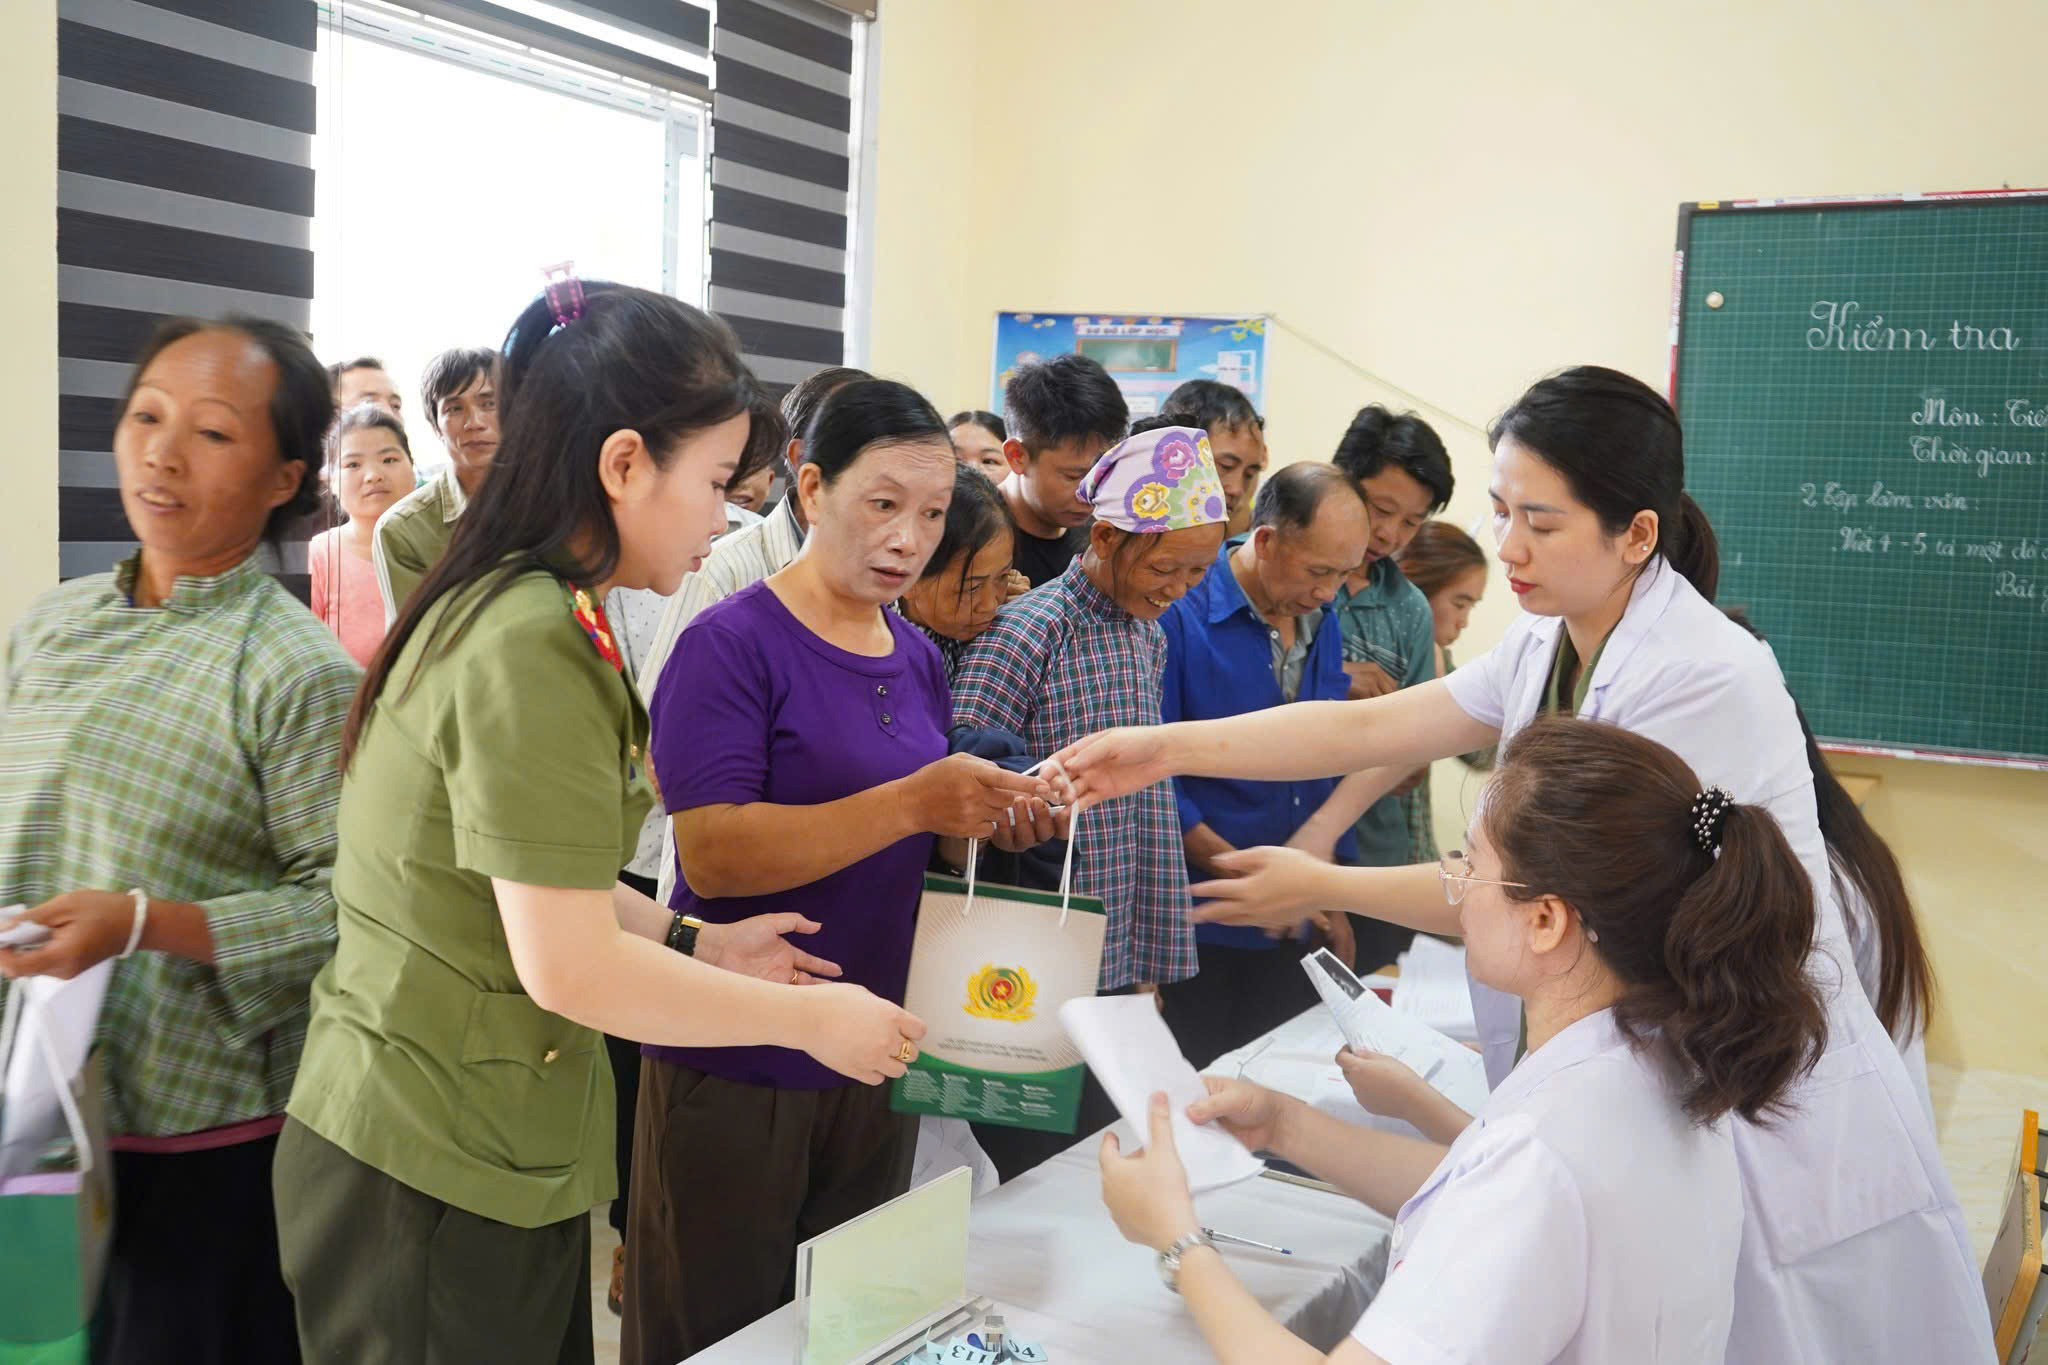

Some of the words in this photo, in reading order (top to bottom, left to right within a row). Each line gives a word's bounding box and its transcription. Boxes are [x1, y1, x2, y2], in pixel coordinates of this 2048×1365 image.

[1806, 301, 1936, 351] Kiểm
[1949, 319, 2020, 351] tra
[1911, 398, 1984, 427] Môn
[1909, 436, 1971, 464] Thời
[1976, 448, 2032, 478] gian
[1912, 531, 1927, 555] 5
